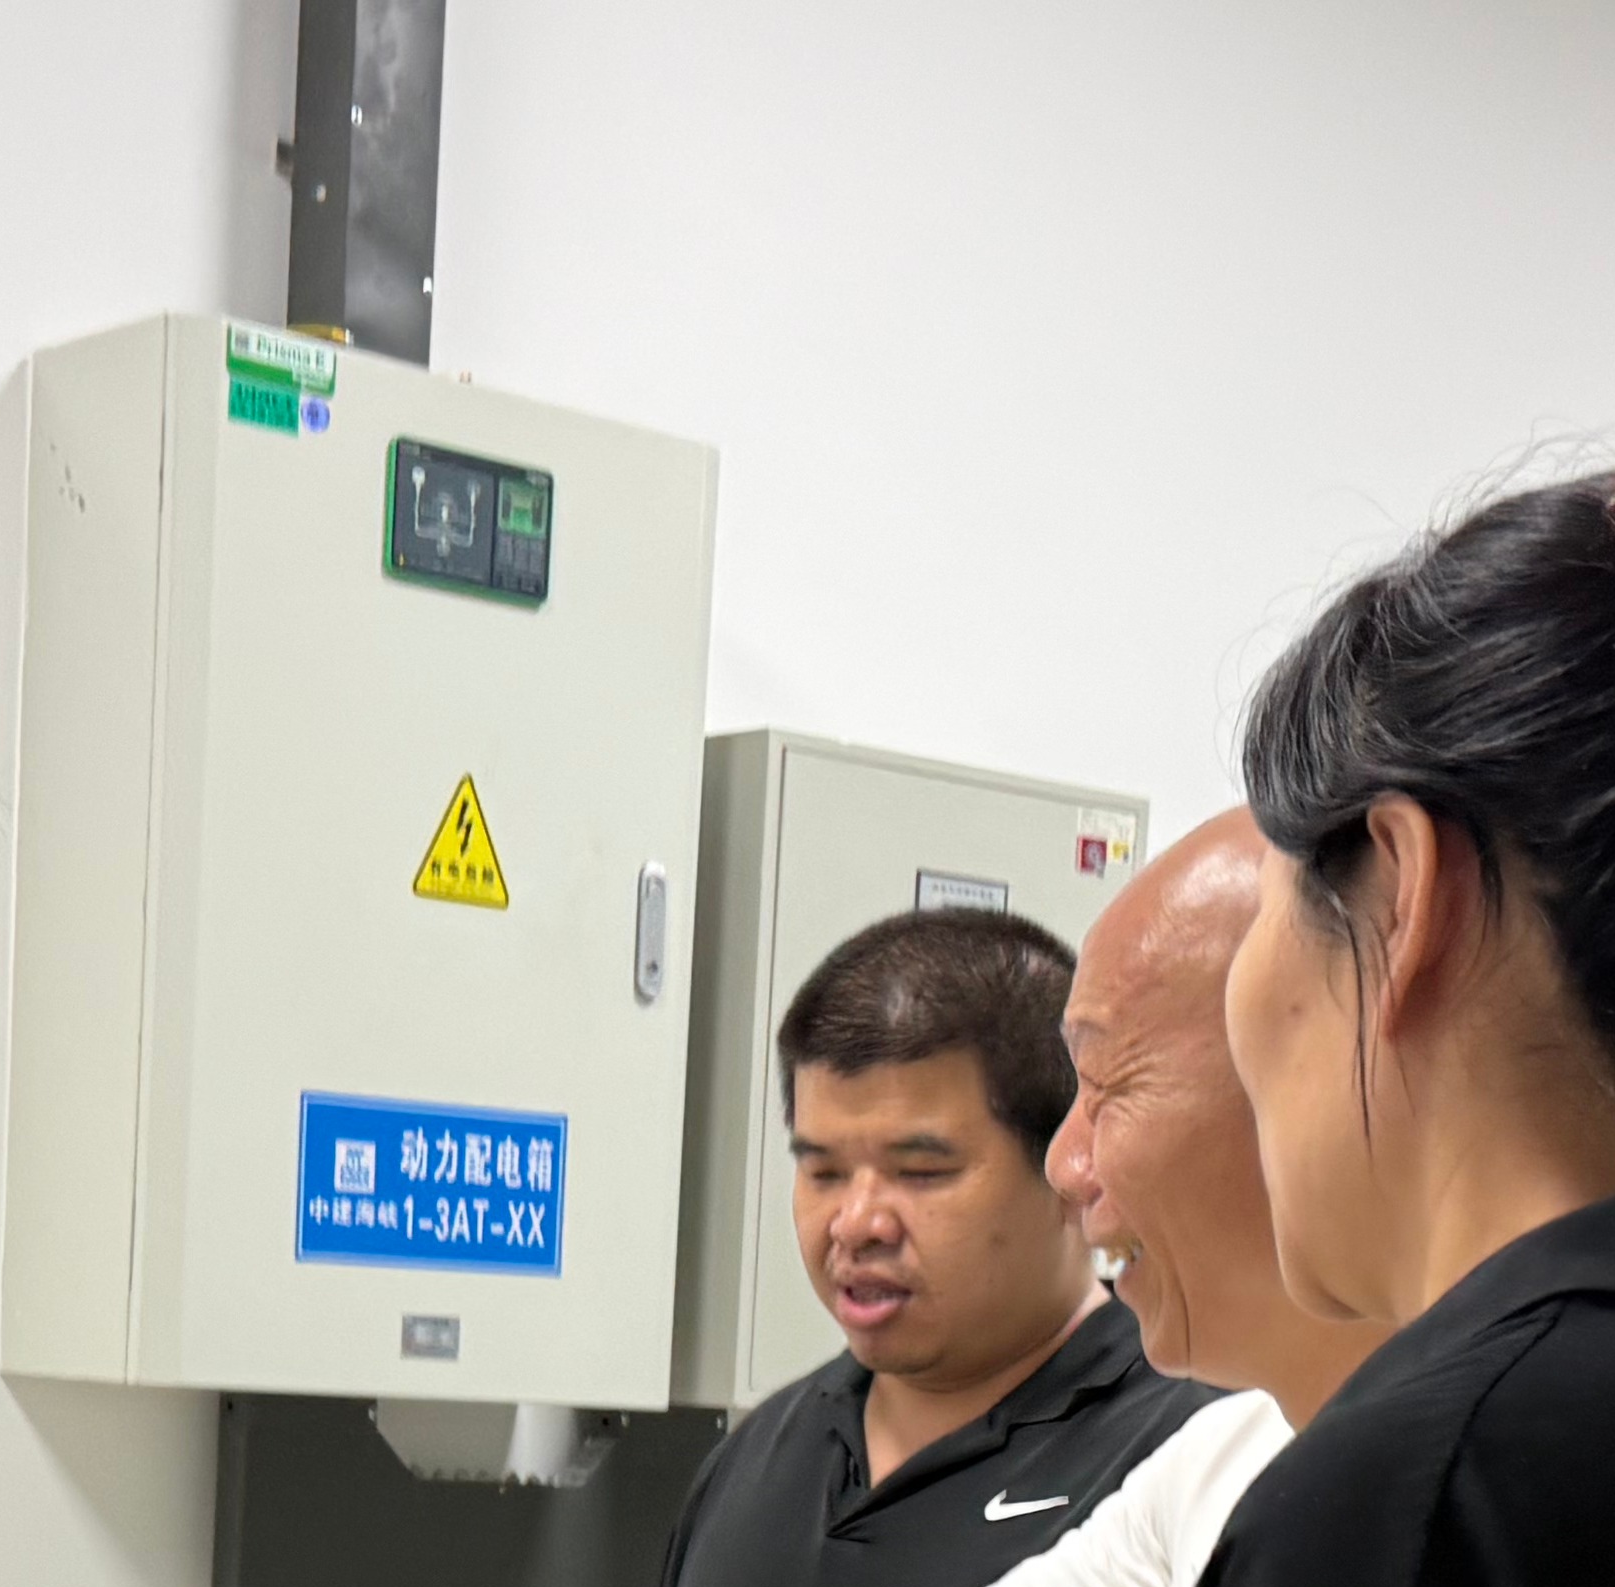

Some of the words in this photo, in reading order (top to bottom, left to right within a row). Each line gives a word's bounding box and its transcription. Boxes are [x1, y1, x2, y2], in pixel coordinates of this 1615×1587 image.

[400, 1125, 554, 1193] 动力配电箱
[403, 1194, 546, 1249] 1-3AT-XX
